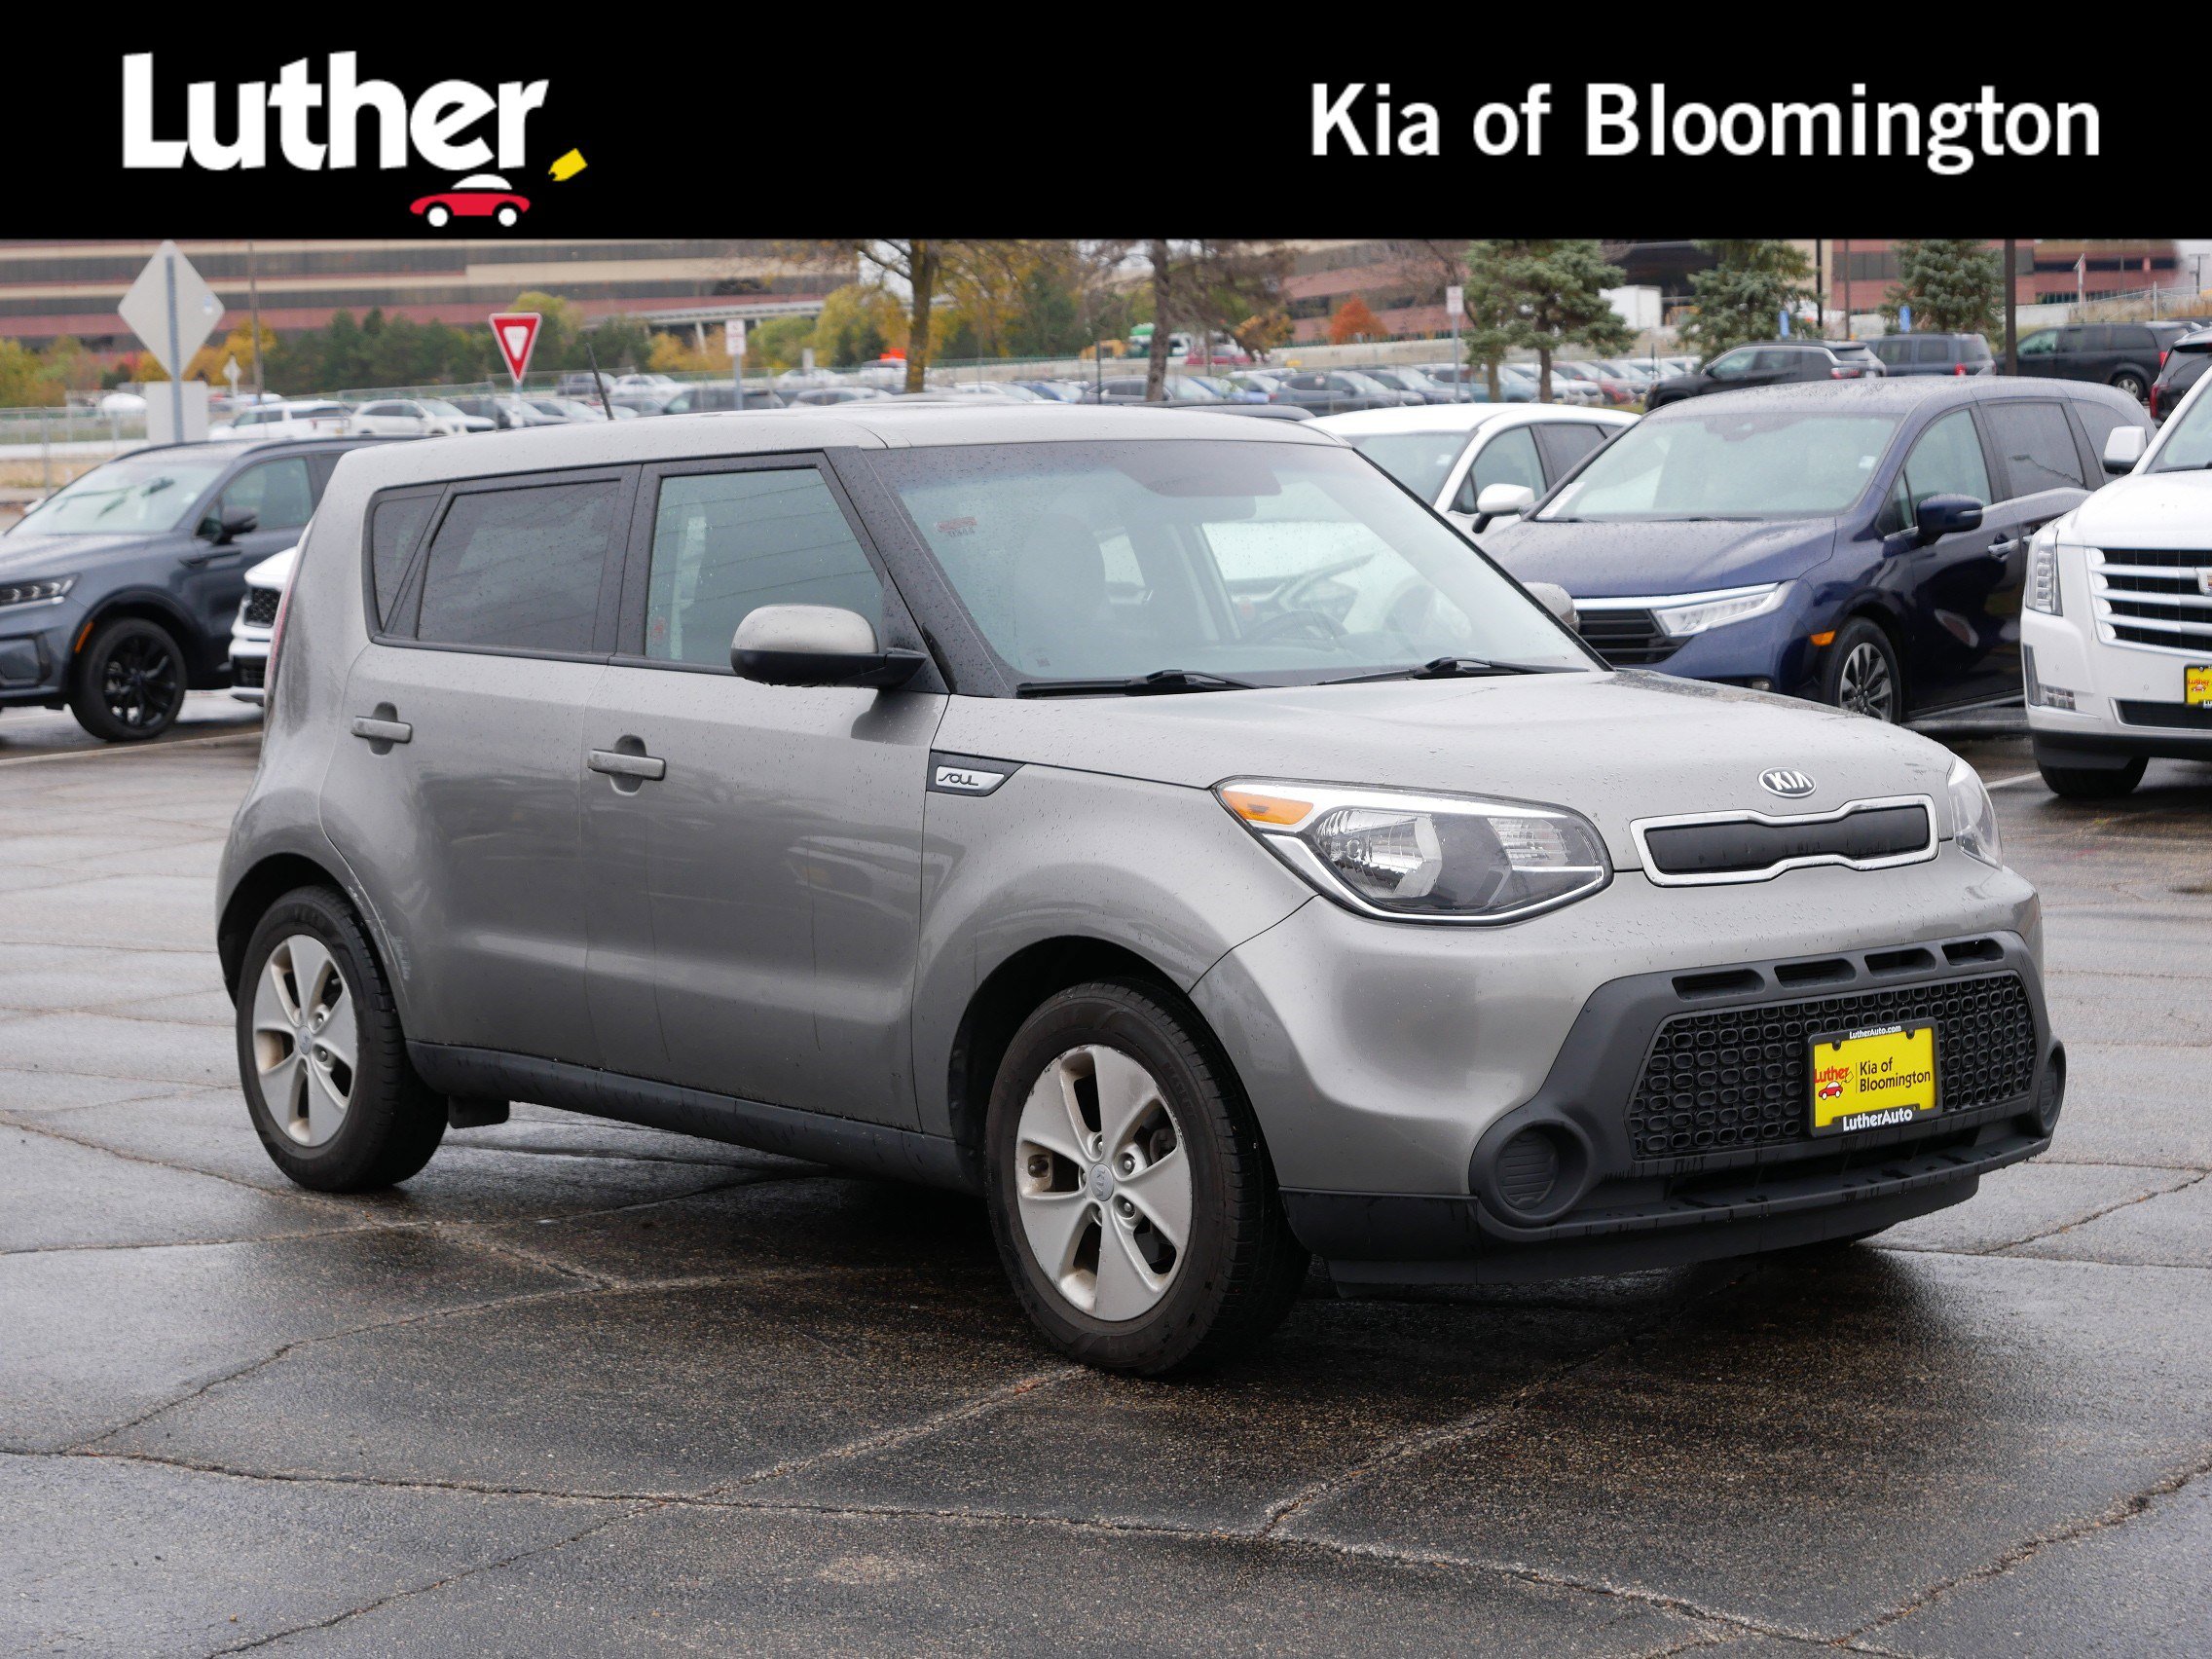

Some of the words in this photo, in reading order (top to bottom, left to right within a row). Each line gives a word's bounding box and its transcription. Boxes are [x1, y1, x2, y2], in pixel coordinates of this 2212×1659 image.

[938, 772, 979, 787] SOUL
[1765, 771, 1813, 791] KIA
[1849, 1025, 1901, 1040] LutherAuto.com
[1814, 1065, 1850, 1084] Luther
[1860, 1060, 1878, 1076] Kia
[1881, 1056, 1894, 1074] of
[1860, 1069, 1931, 1092] Bloomington
[1842, 1108, 1913, 1132] LutherAuto
